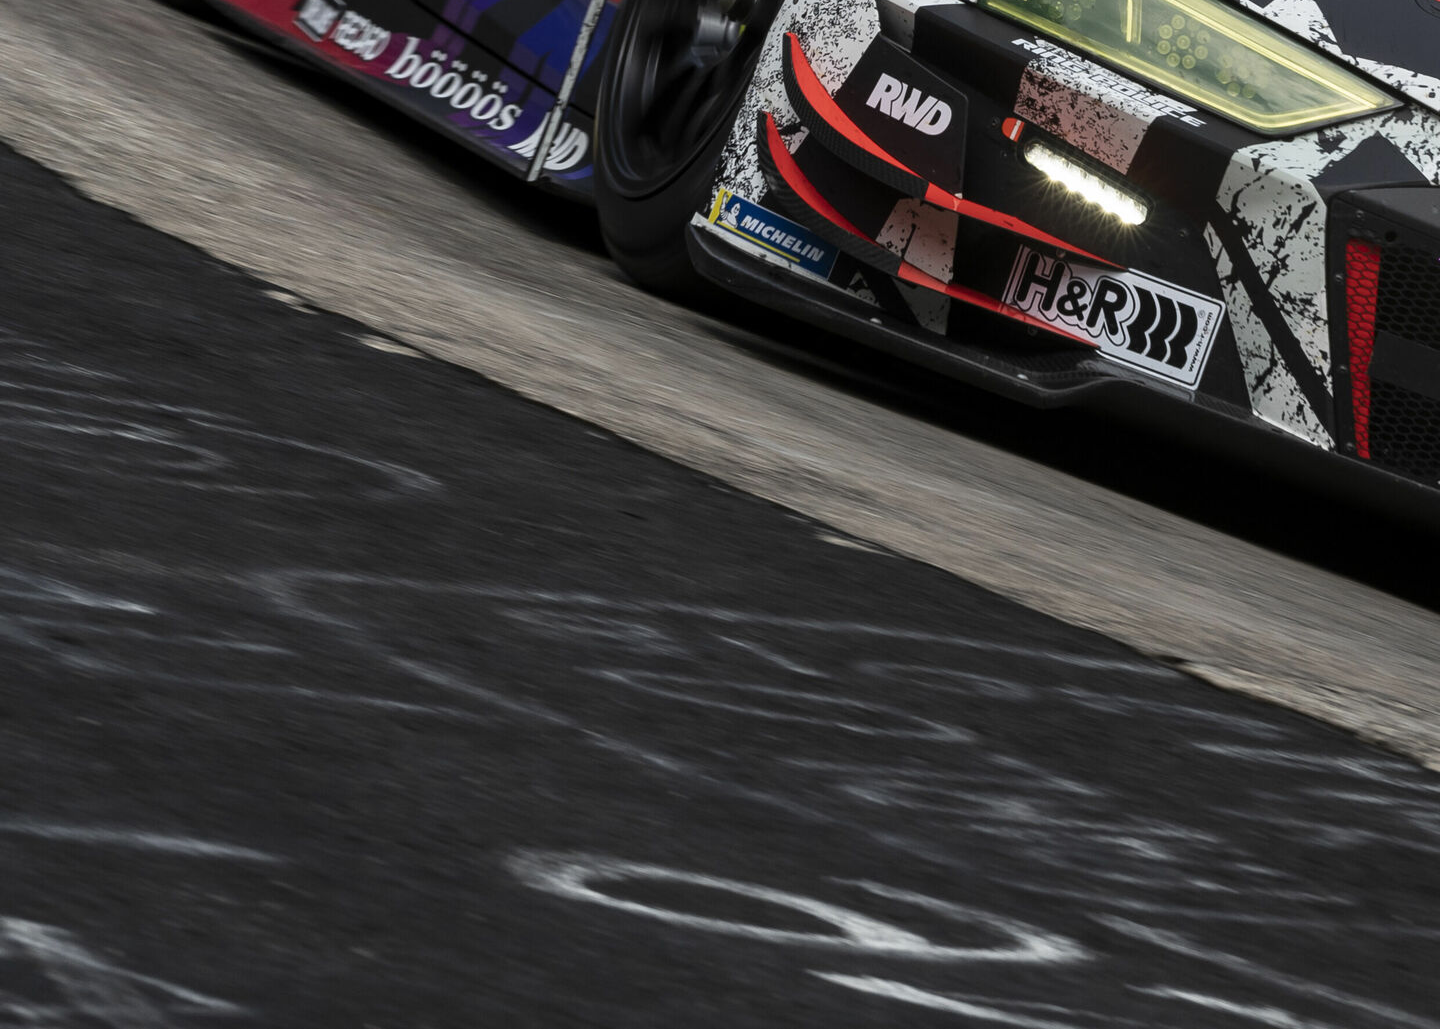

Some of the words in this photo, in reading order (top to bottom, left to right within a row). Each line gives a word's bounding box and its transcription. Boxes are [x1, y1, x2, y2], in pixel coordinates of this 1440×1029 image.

[866, 72, 952, 136] RWD
[740, 215, 825, 262] MICHELIN
[1014, 250, 1129, 338] H&R
